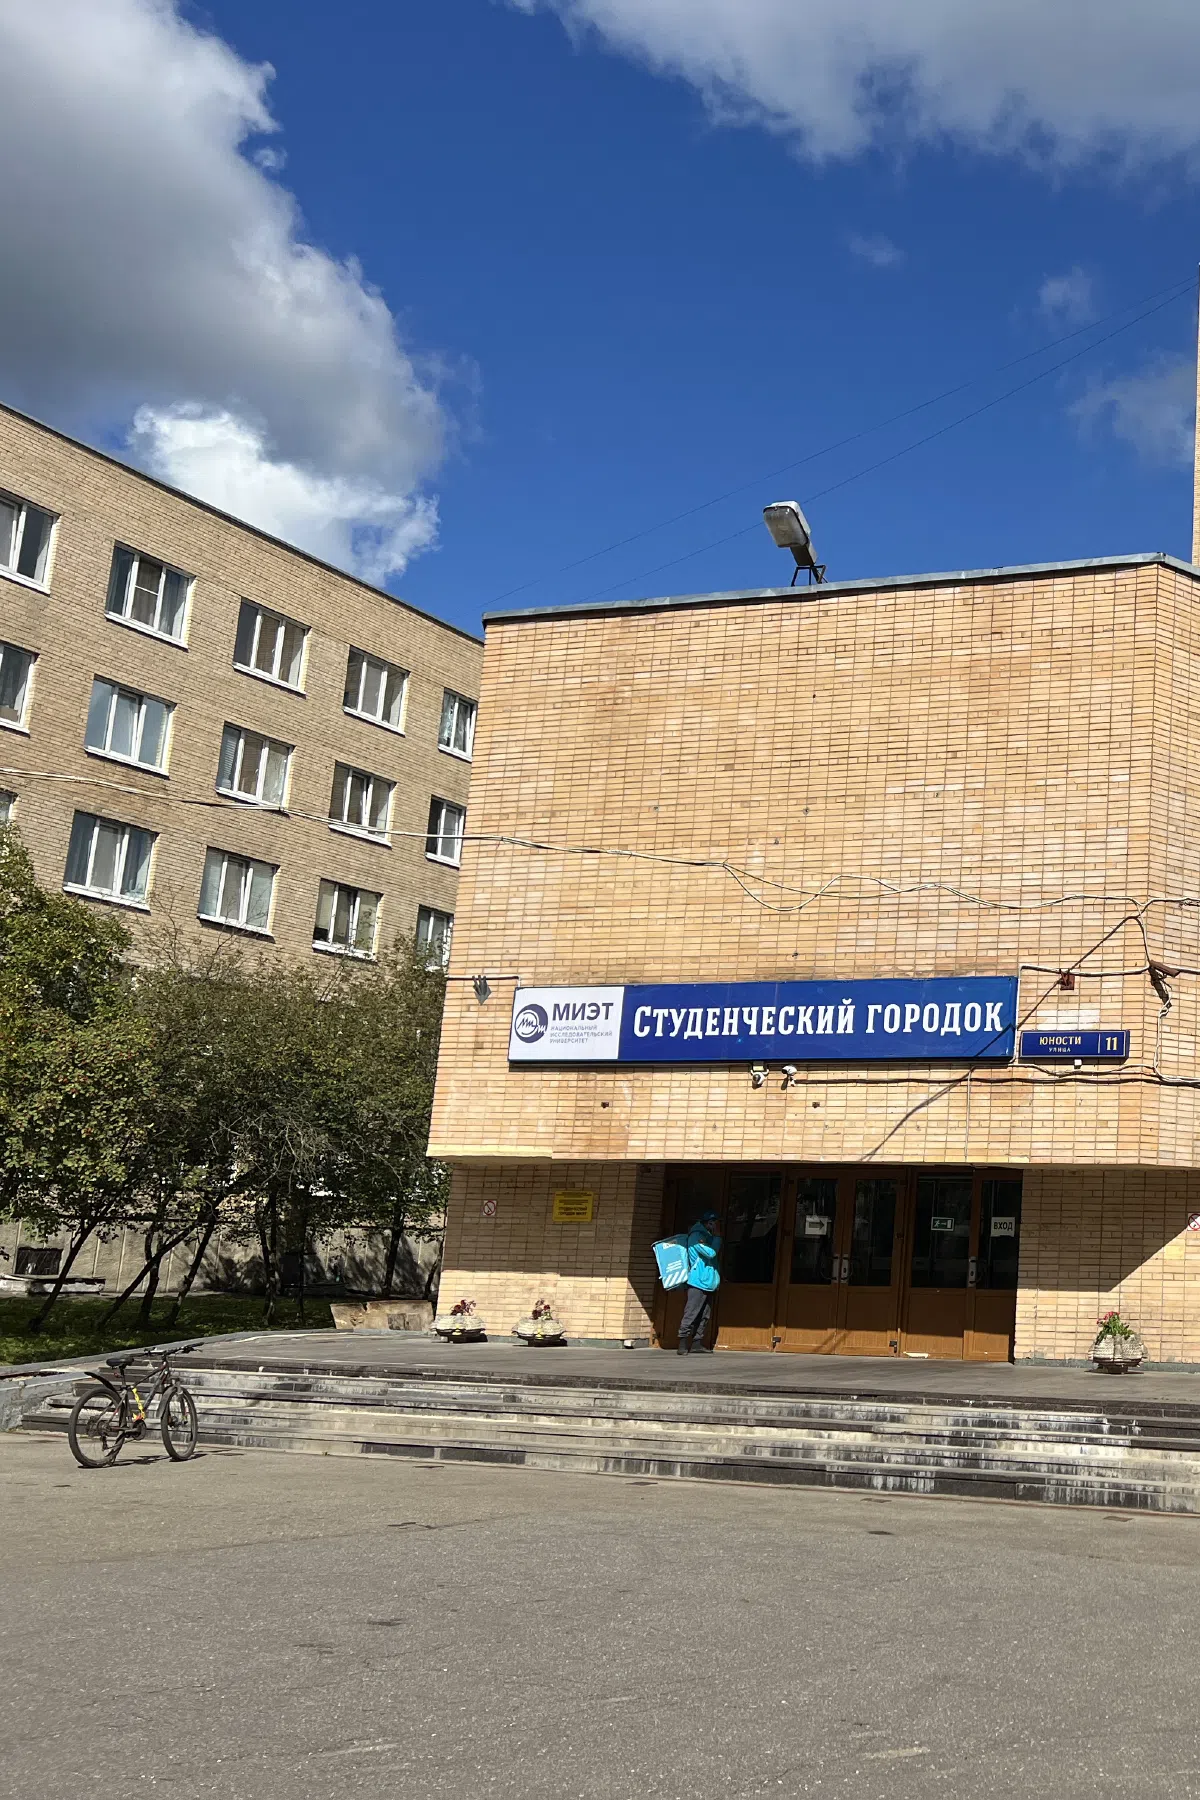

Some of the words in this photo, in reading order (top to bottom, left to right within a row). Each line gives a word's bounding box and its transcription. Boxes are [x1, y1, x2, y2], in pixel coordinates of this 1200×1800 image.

[552, 1002, 614, 1021] МИЭТ
[633, 998, 856, 1040] СТУДЕНЧЕСКИЙ
[865, 1002, 1003, 1036] ГОРОДОК
[549, 1030, 613, 1038] ИССЛЕДОВАТЕЛЬСКИЙ
[1039, 1036, 1081, 1045] ЮНОСТИ
[1105, 1036, 1118, 1051] 11
[993, 1221, 1013, 1231] ВХОД
